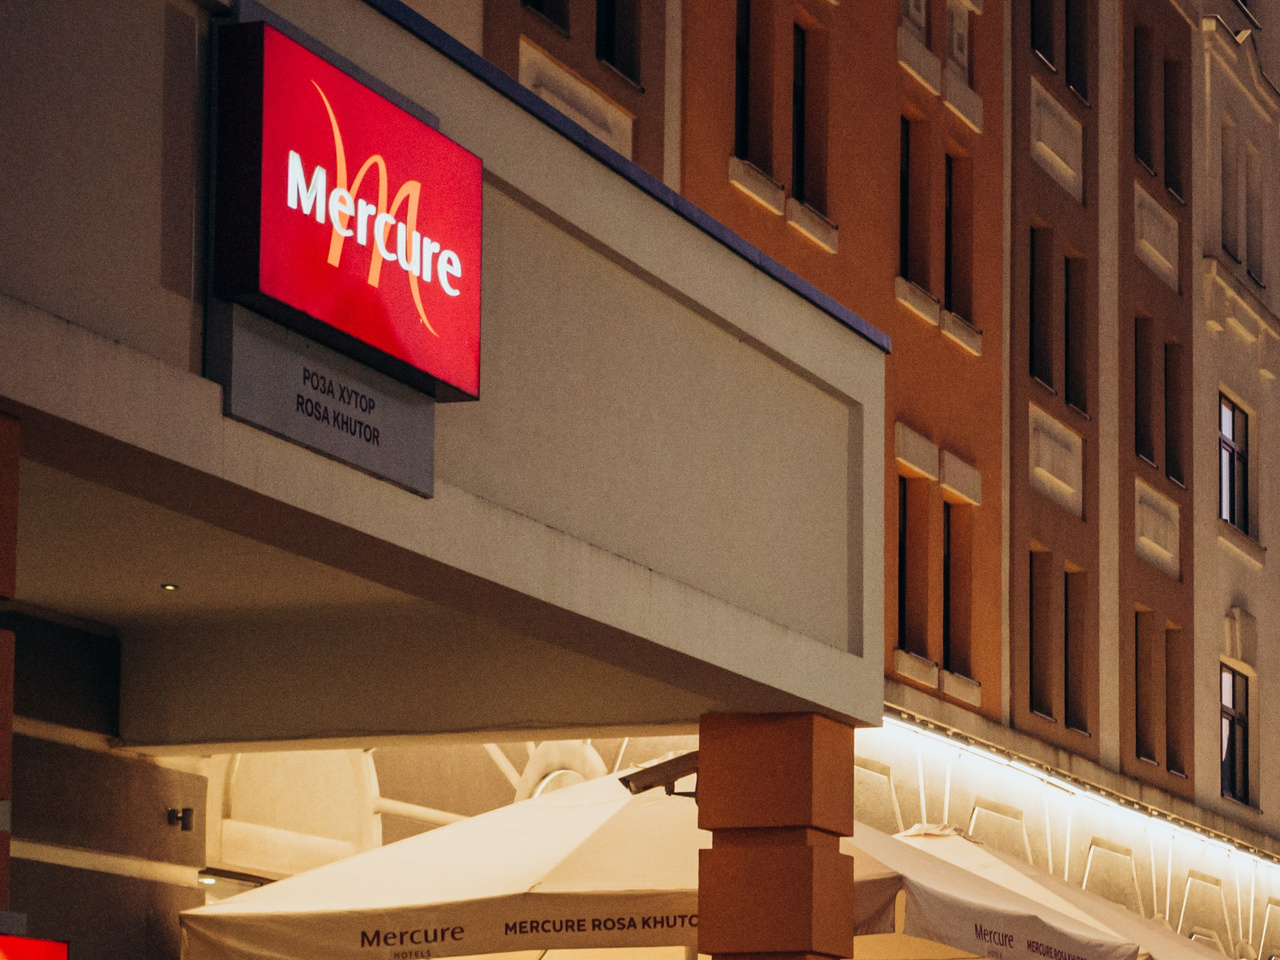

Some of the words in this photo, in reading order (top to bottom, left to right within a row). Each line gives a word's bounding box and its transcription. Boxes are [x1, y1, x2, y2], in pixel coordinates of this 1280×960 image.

[287, 149, 462, 297] Mercure
[303, 366, 335, 399] РОЗА
[338, 383, 376, 415] ХУТОР
[296, 393, 331, 426] ROSA
[332, 409, 380, 447] KHUTOR
[360, 925, 465, 949] Mercure
[504, 919, 587, 936] MERCURE
[591, 915, 638, 932] ROSA
[974, 922, 1014, 949] Mercure
[394, 950, 431, 960] HOTELS
[1027, 939, 1053, 960] MERCURE
